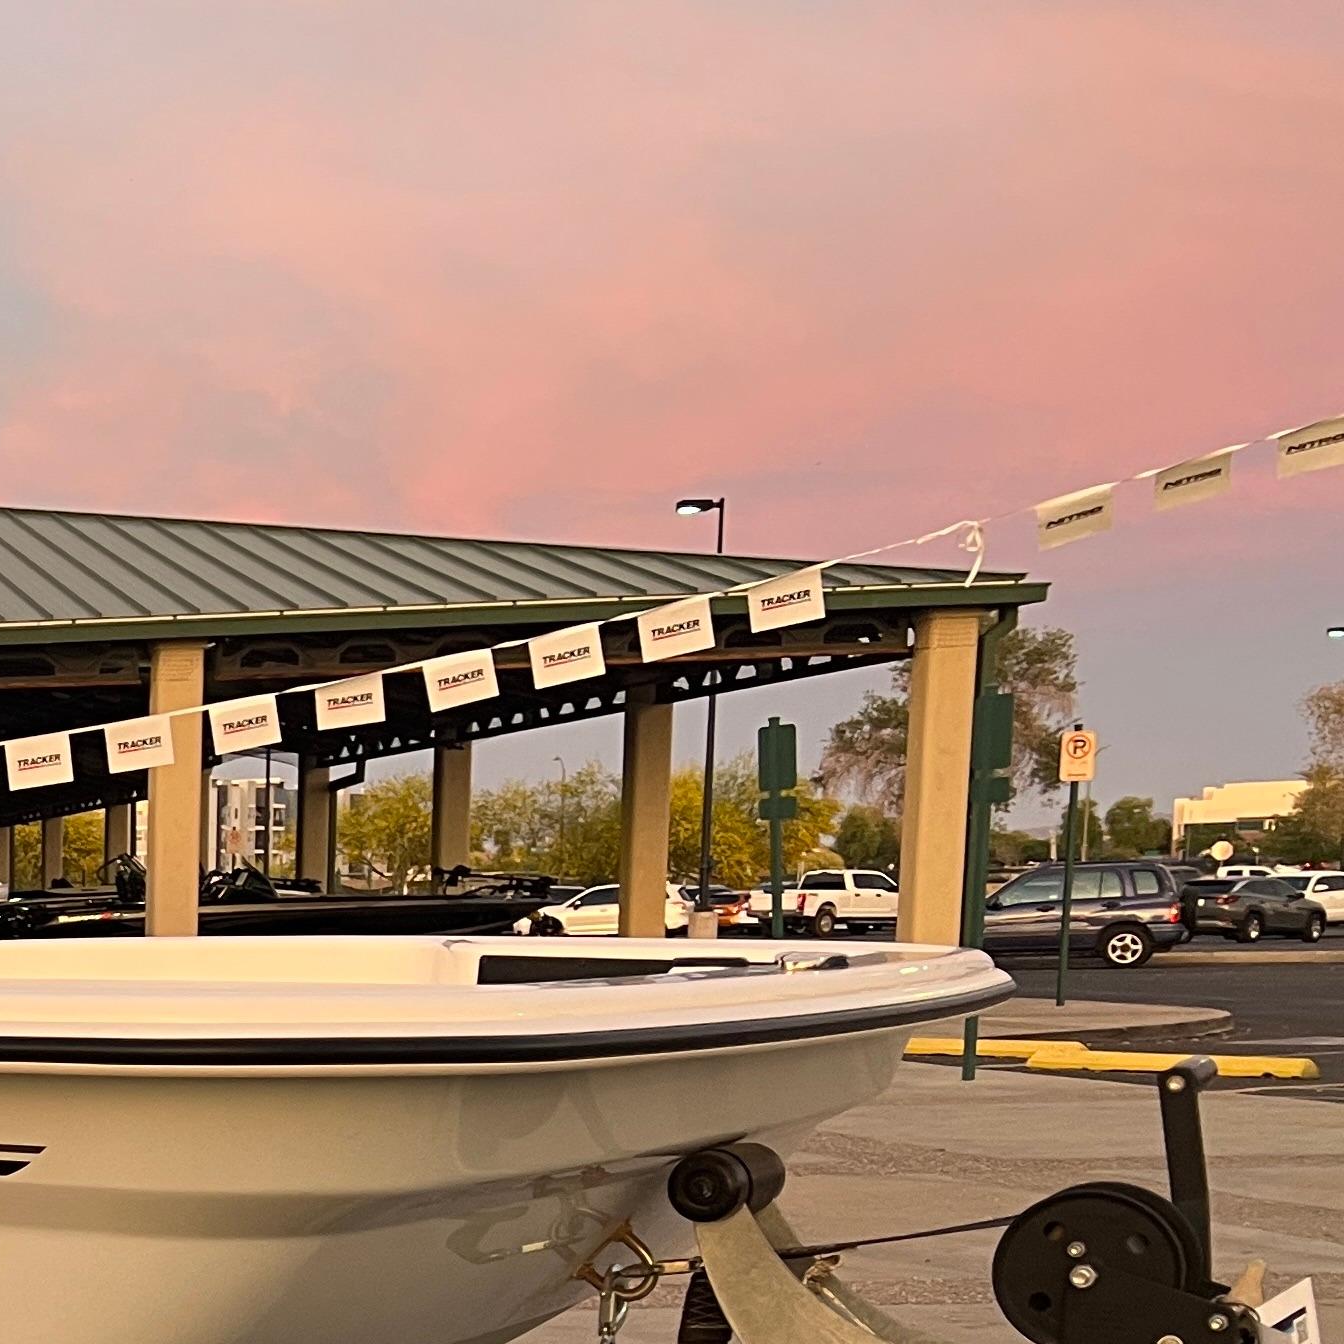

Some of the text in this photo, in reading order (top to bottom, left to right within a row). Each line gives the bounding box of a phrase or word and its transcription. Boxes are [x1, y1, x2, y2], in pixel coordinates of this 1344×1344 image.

[1045, 505, 1104, 530] NITRO
[761, 588, 811, 608] TRACKER
[651, 618, 700, 639] TRACKER
[542, 645, 591, 665] TRACKER
[437, 668, 484, 688] TRACKER
[326, 692, 373, 707] TRACKER
[222, 715, 268, 732] TRACKER
[117, 735, 162, 751] TRACKER
[17, 753, 62, 768] TRACKER
